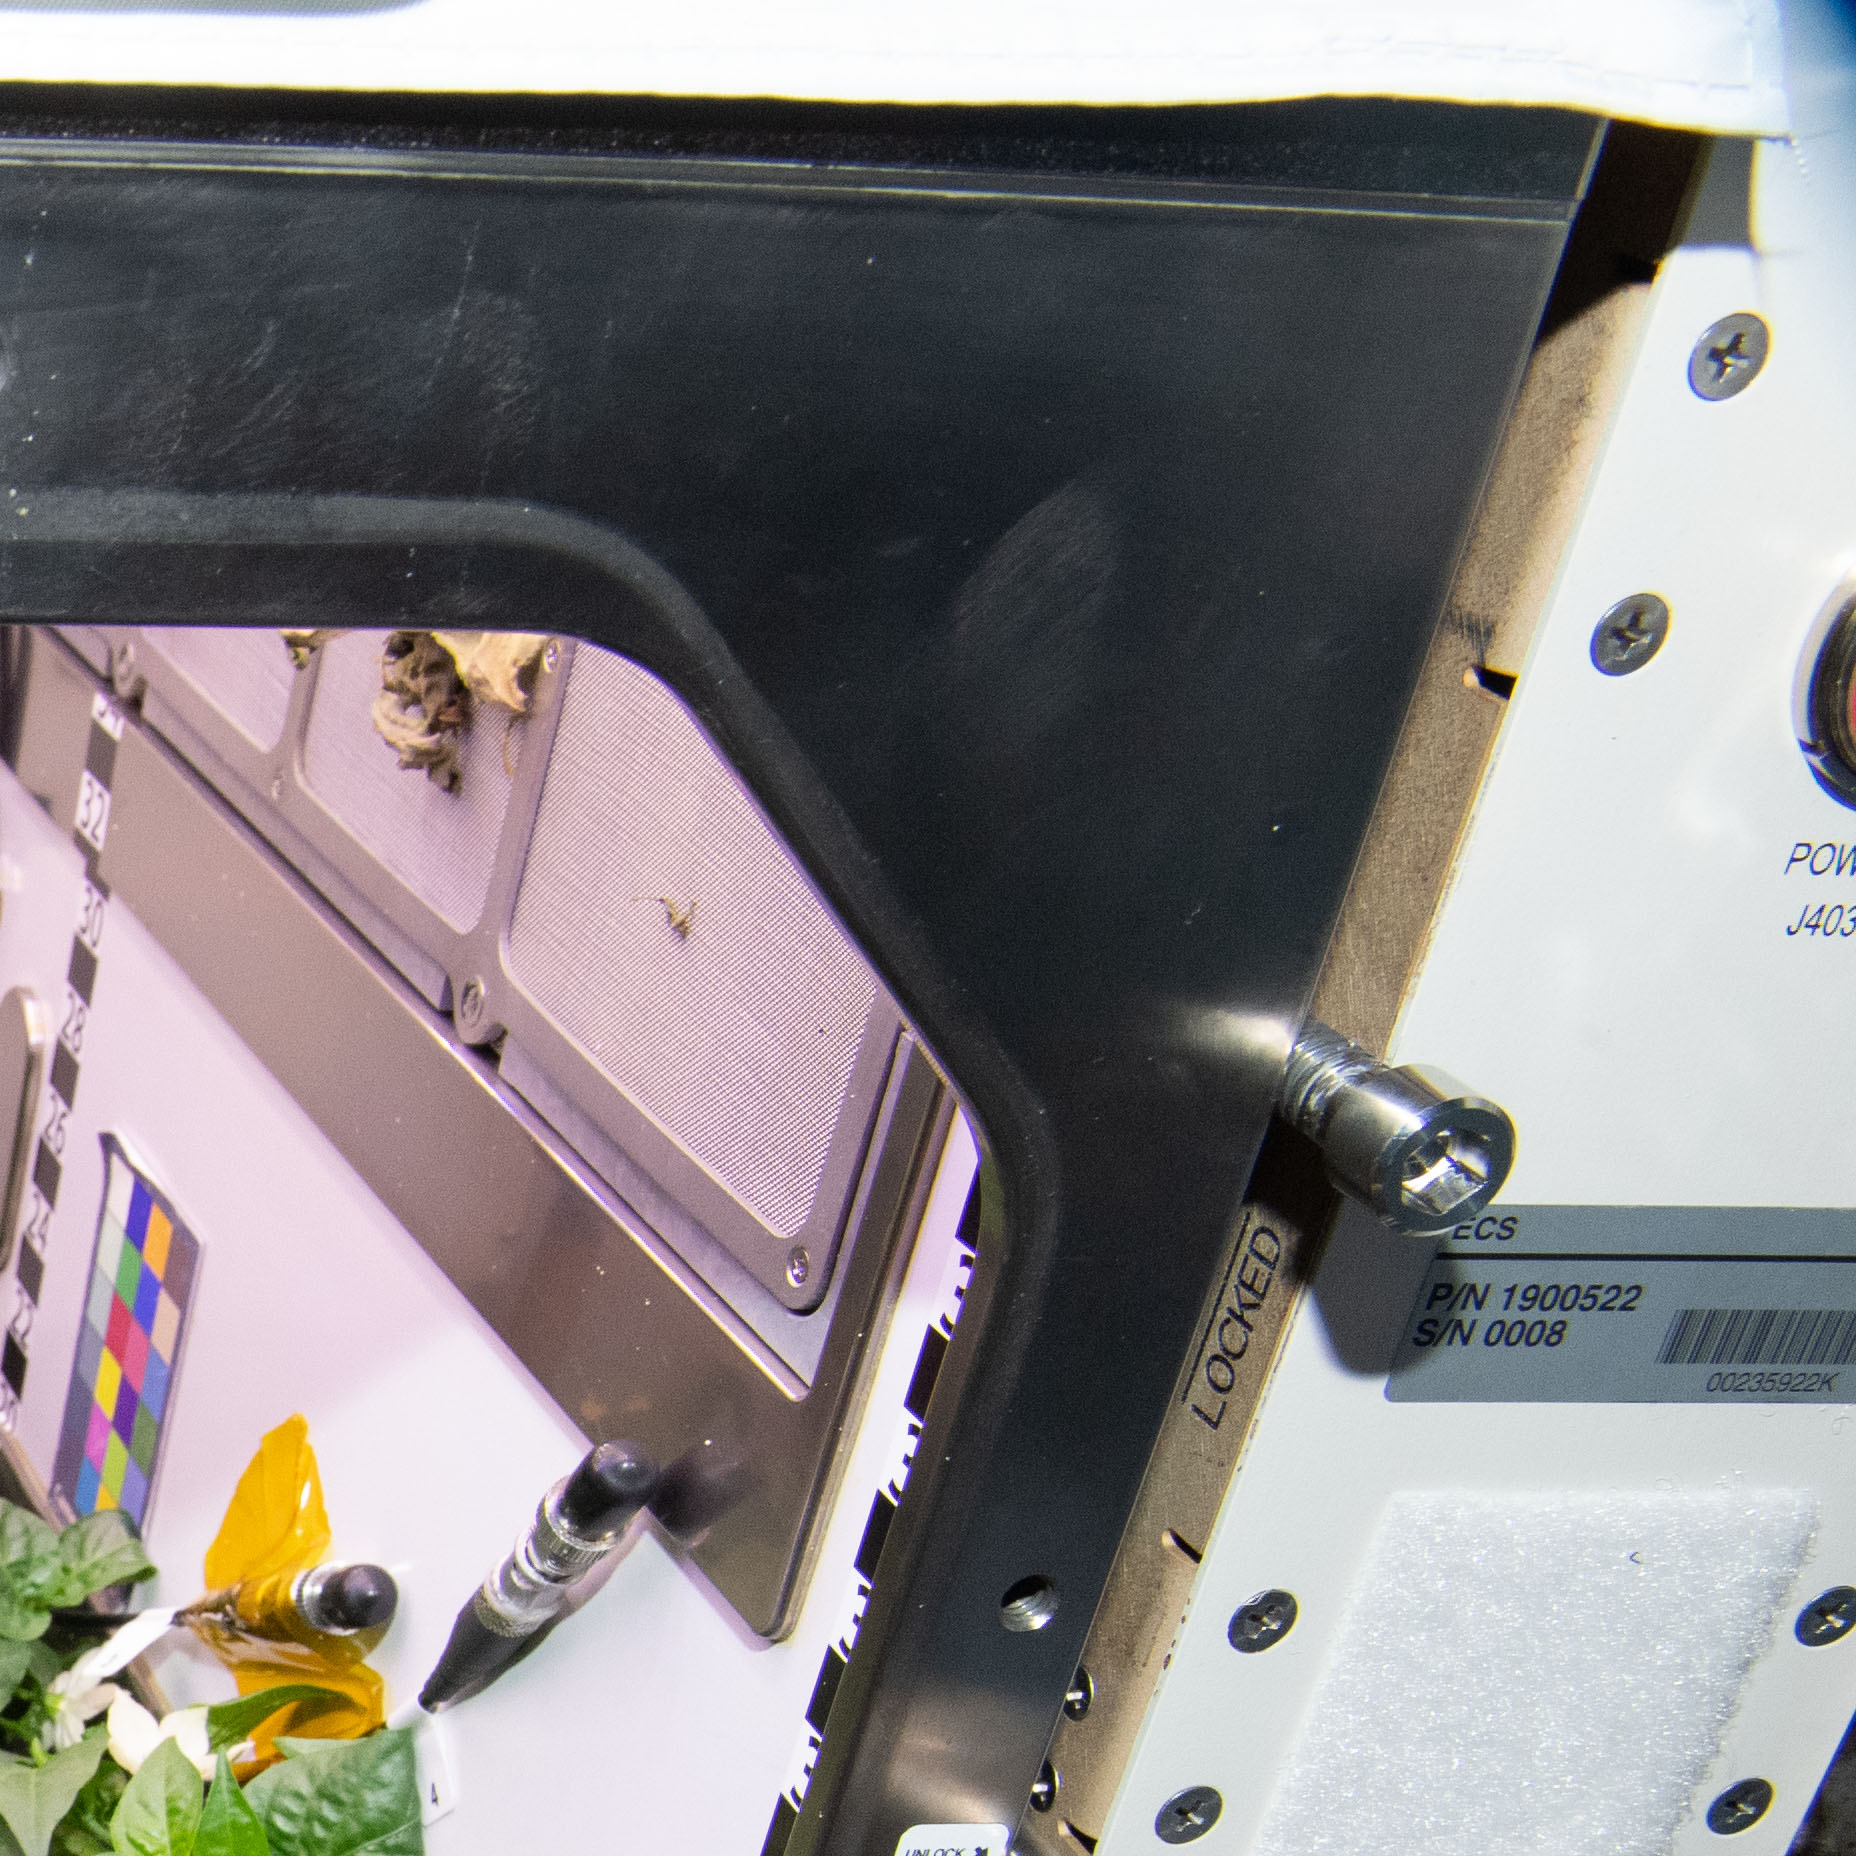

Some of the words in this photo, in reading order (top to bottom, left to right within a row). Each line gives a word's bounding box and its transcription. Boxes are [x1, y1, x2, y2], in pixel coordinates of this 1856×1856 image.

[1452, 1215, 1519, 1240] ECS
[1425, 1283, 1491, 1312] P/N
[1501, 1283, 1644, 1312] 1900522
[1191, 1225, 1281, 1431] LOCKED
[1412, 1319, 1477, 1348] S/N
[1483, 1319, 1570, 1347] 0008
[1705, 1372, 1838, 1393] 00235922K
